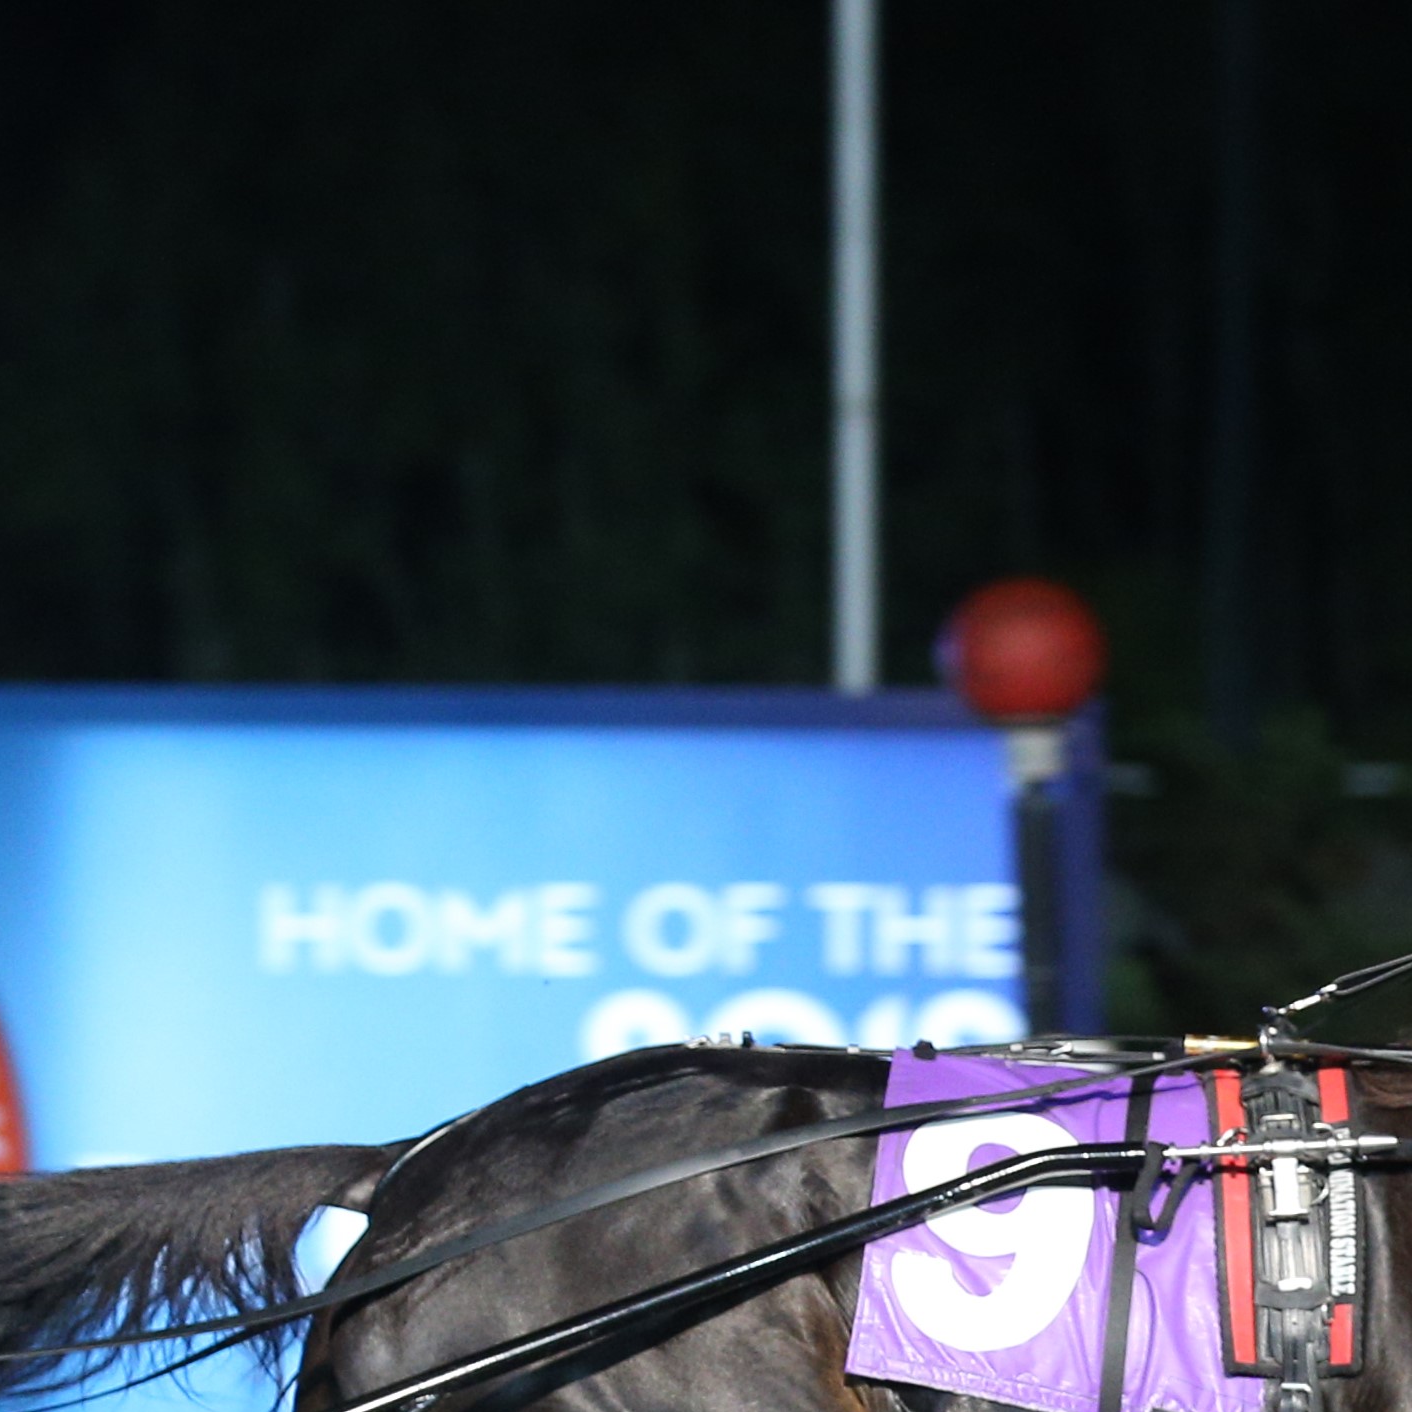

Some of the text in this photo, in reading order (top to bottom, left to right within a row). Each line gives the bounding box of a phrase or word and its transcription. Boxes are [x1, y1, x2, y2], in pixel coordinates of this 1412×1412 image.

[259, 879, 1025, 979] HOME OF THE
[891, 1111, 1095, 1353] 9
[1329, 1237, 1357, 1297] STABLE
